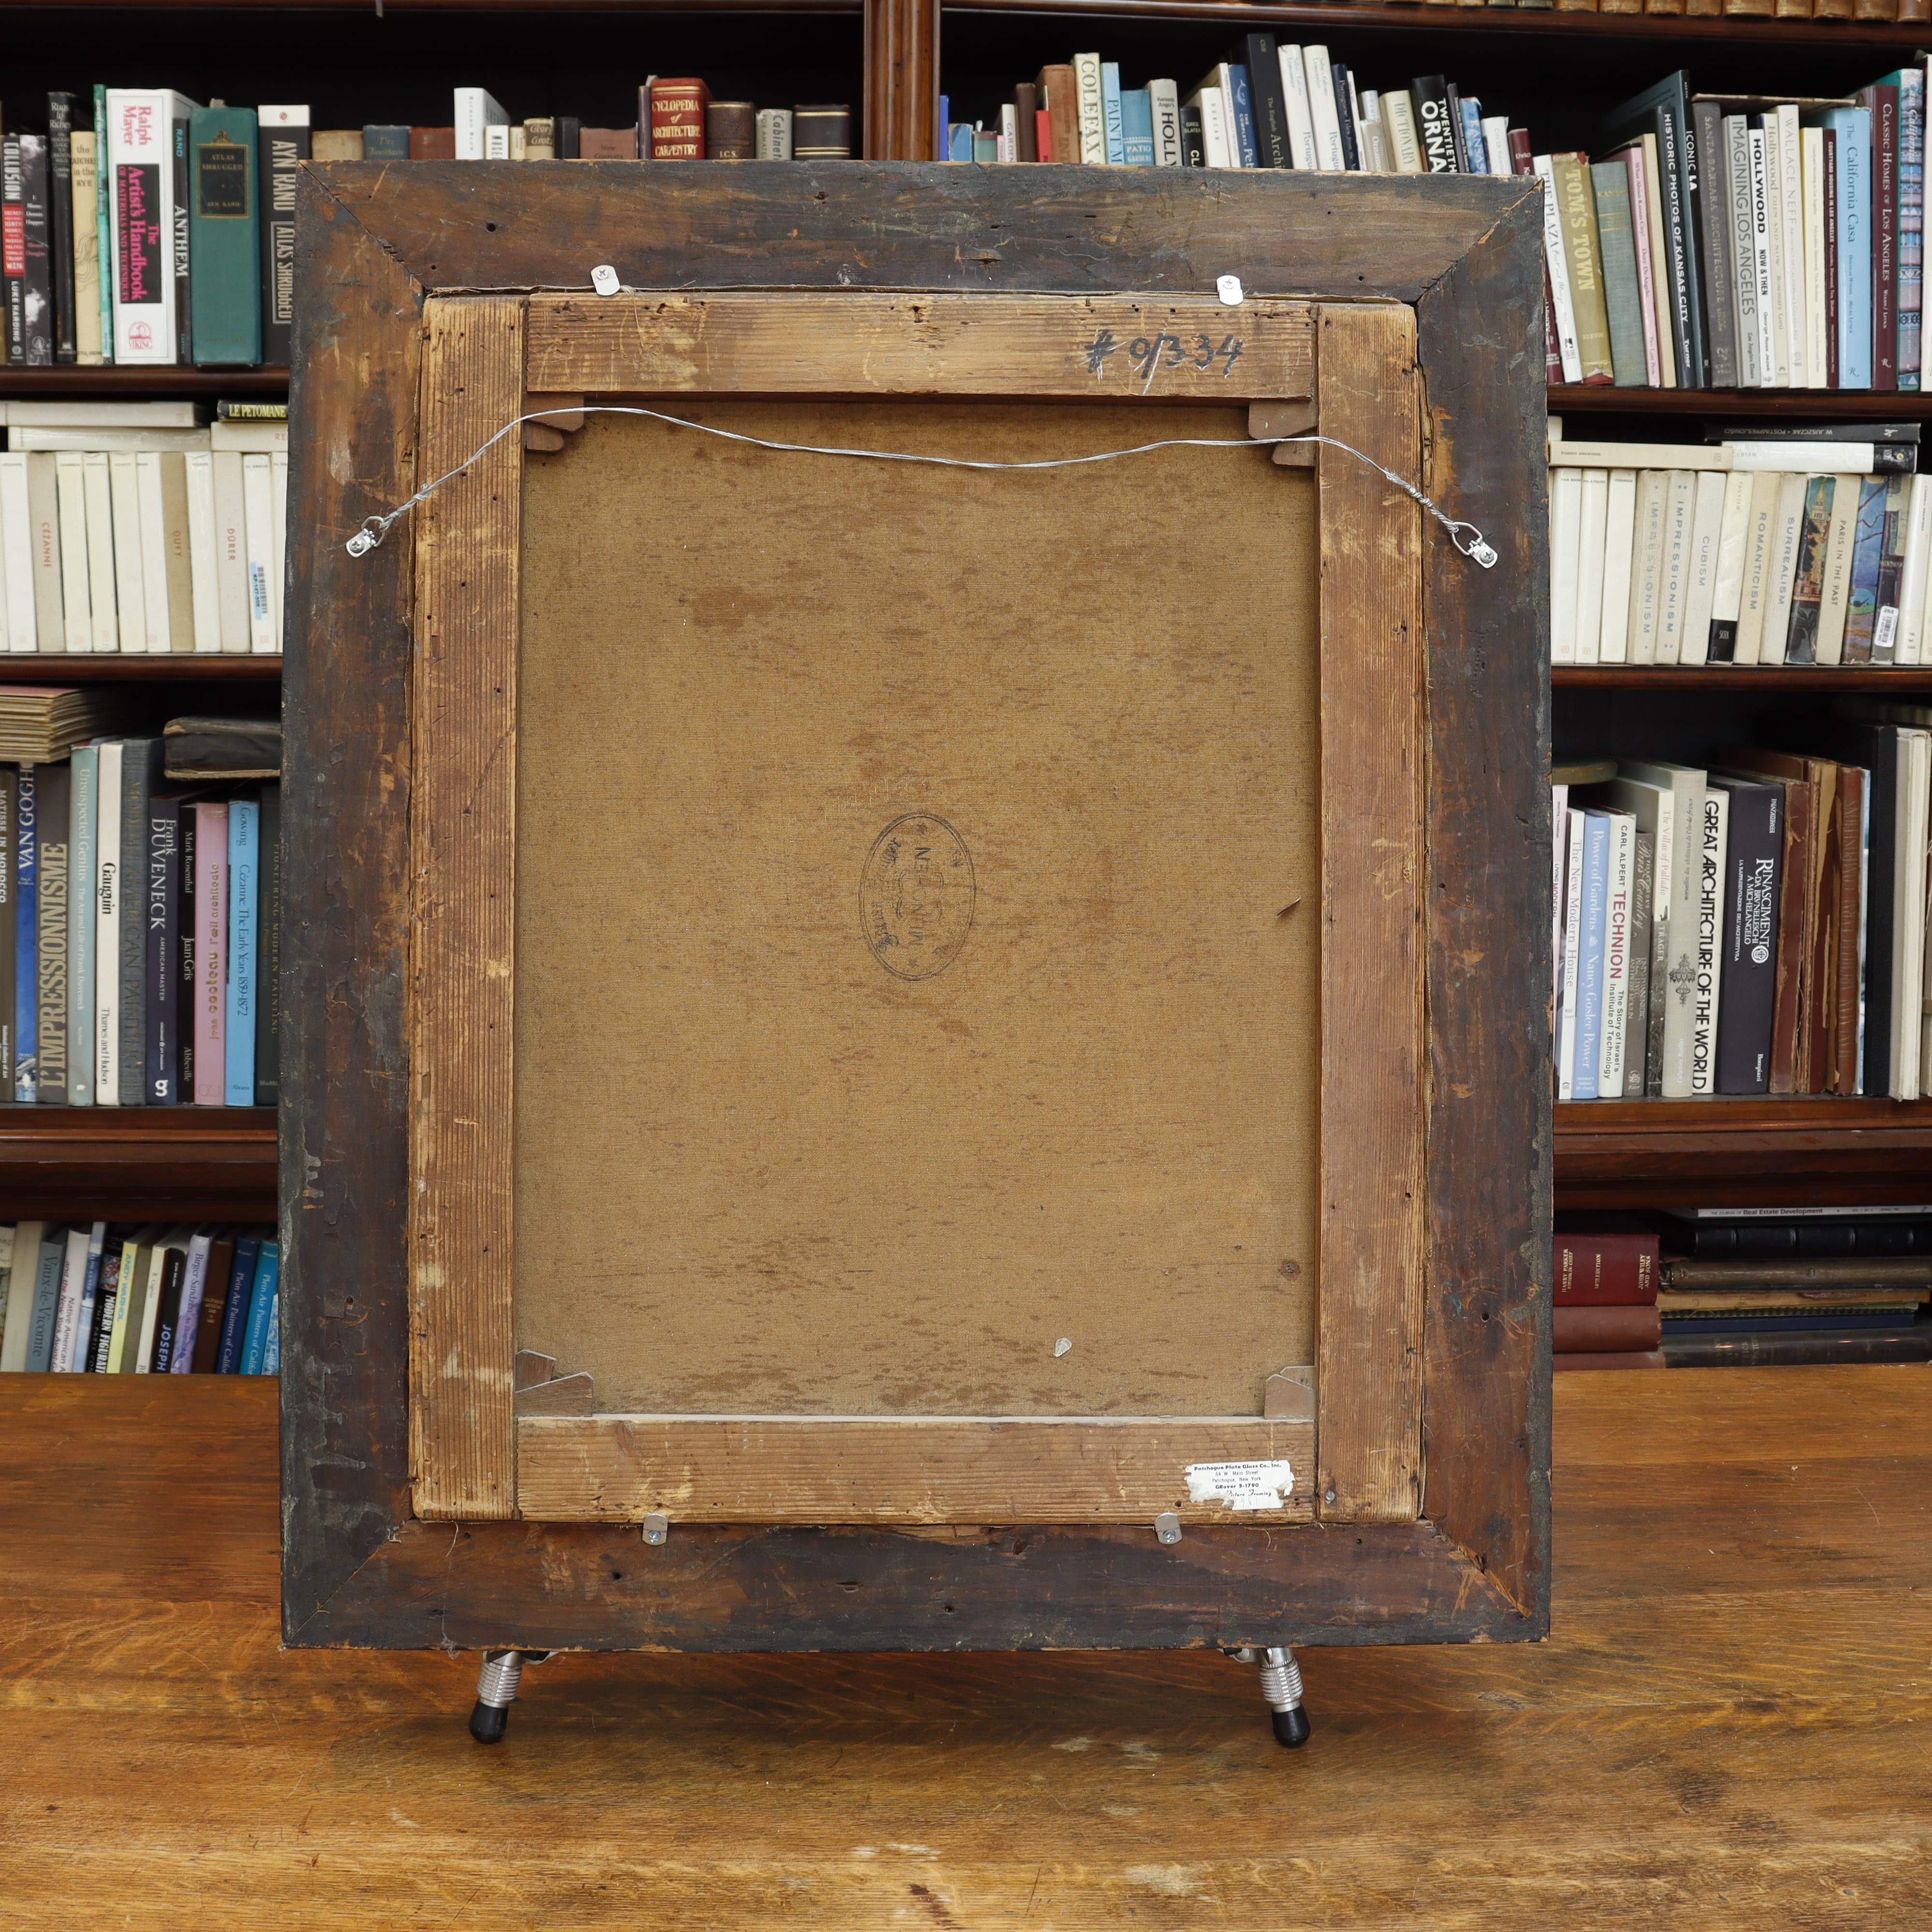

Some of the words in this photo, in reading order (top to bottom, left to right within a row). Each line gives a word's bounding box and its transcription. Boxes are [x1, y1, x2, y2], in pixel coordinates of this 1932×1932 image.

[652, 99, 699, 111] CYCLOPEDIA
[1081, 60, 1100, 155] COLEFAX
[1107, 99, 1122, 142] PAINT
[121, 105, 136, 145] Mayer
[135, 106, 152, 145] Ralph
[652, 126, 700, 138] ARCHITECTURE
[1394, 102, 1416, 165] DICTIONARY
[1438, 98, 1458, 172] TWENTIETH
[1664, 114, 1676, 170] HISTORIC
[272, 141, 297, 168] AYN
[655, 144, 697, 156] CARPENTRY
[1686, 130, 1696, 170] ICONIC
[1732, 121, 1748, 209] IMAGINING
[1768, 126, 1779, 190] Hollywood
[1785, 118, 1795, 183] WALLACE
[3, 142, 20, 200] COLLUSION
[1754, 139, 1765, 233] HOLLYWOOD
[1847, 147, 1859, 209] California
[1883, 153, 1892, 190] HOMES
[273, 174, 296, 211] RAND
[1565, 169, 1587, 228] TOM'S
[1669, 174, 1680, 223] PHOTOS
[1787, 190, 1796, 224] NEFF
[148, 224, 159, 245] The
[1545, 203, 1559, 247] PLAZA
[1674, 227, 1681, 242] OF
[1737, 213, 1750, 241] LOS
[1847, 214, 1859, 242] Casa
[1882, 209, 1892, 229] LOS
[174, 205, 188, 277] ANTHEM
[1883, 233, 1892, 281] ANGELES
[130, 220, 147, 300] Handbook
[1573, 234, 1595, 290] TOWN
[1676, 246, 1686, 292] KANSAS
[11, 281, 20, 302] LUKE
[1739, 245, 1755, 315] ANGELES
[12, 305, 21, 342] HARDING
[1680, 297, 1688, 322] CITY
[228, 404, 240, 417] LE
[242, 405, 286, 417] PETOMANE
[1837, 520, 1847, 545] PARIS
[1667, 501, 1684, 632] IMPRESSIONISM
[1699, 536, 1710, 586] CUBISM
[1749, 512, 1767, 610] ROMANTICISM
[1779, 517, 1794, 604] SURREALISM
[1834, 565, 1842, 581] THE
[1837, 551, 1843, 559] IN
[19, 764, 34, 826] GOGH
[77, 769, 90, 839] Unsuspected
[236, 808, 251, 846] Gowing
[1663, 810, 1671, 826] The
[1704, 800, 1719, 852] GREAT
[19, 831, 34, 869] VAN
[165, 819, 177, 855] Frank
[185, 832, 193, 852] Mark
[1573, 839, 1582, 862] The
[1592, 830, 1604, 866] Power
[1662, 828, 1671, 851] Villas
[78, 841, 89, 881] Genius
[150, 818, 166, 930] DUVENECK
[185, 855, 193, 893] Rosenthal
[1591, 868, 1602, 881] of
[98, 863, 115, 914] Gauguin
[1571, 868, 1580, 893] New
[1568, 898, 1579, 942] Modern
[1589, 881, 1602, 930] Gardens
[1698, 855, 1717, 969] ARCHITECTURE
[1744, 884, 1753, 945] MICHELANGELO
[181, 936, 194, 958] Juan
[1610, 891, 1627, 979] TECHNION
[1657, 926, 1665, 962] TRAGER
[184, 959, 194, 980] Gris
[1566, 950, 1577, 987] House
[1582, 954, 1599, 991] Nancy
[1697, 973, 1712, 996] OF
[1584, 992, 1596, 1030] Goslee
[1608, 984, 1616, 1016] Institute
[1615, 1008, 1623, 1029] Story
[1696, 999, 1710, 1025] THE
[100, 1008, 110, 1038] Thames
[1608, 1018, 1613, 1028] of
[101, 1040, 109, 1054] and
[183, 1047, 192, 1081] Abbeville
[1582, 1033, 1595, 1068] Power
[1603, 1031, 1614, 1079] Technology
[1614, 1039, 1623, 1072] Israel's
[1693, 1028, 1709, 1090] WORLD
[101, 1056, 110, 1084] Hudson
[1755, 1053, 1763, 1082] Bompiani
[191, 1253, 203, 1279] Birger
[234, 1272, 244, 1290] Plein
[261, 1274, 271, 1292] Plein
[66, 1297, 75, 1323] Native
[101, 1295, 115, 1332] MODERN
[117, 1283, 128, 1321] WARHOL
[227, 1307, 239, 1336] Painters
[254, 1309, 265, 1338] Painters
[60, 1327, 71, 1364] American
[156, 1324, 171, 1371] JOSEPH
[252, 1340, 259, 1349] of
